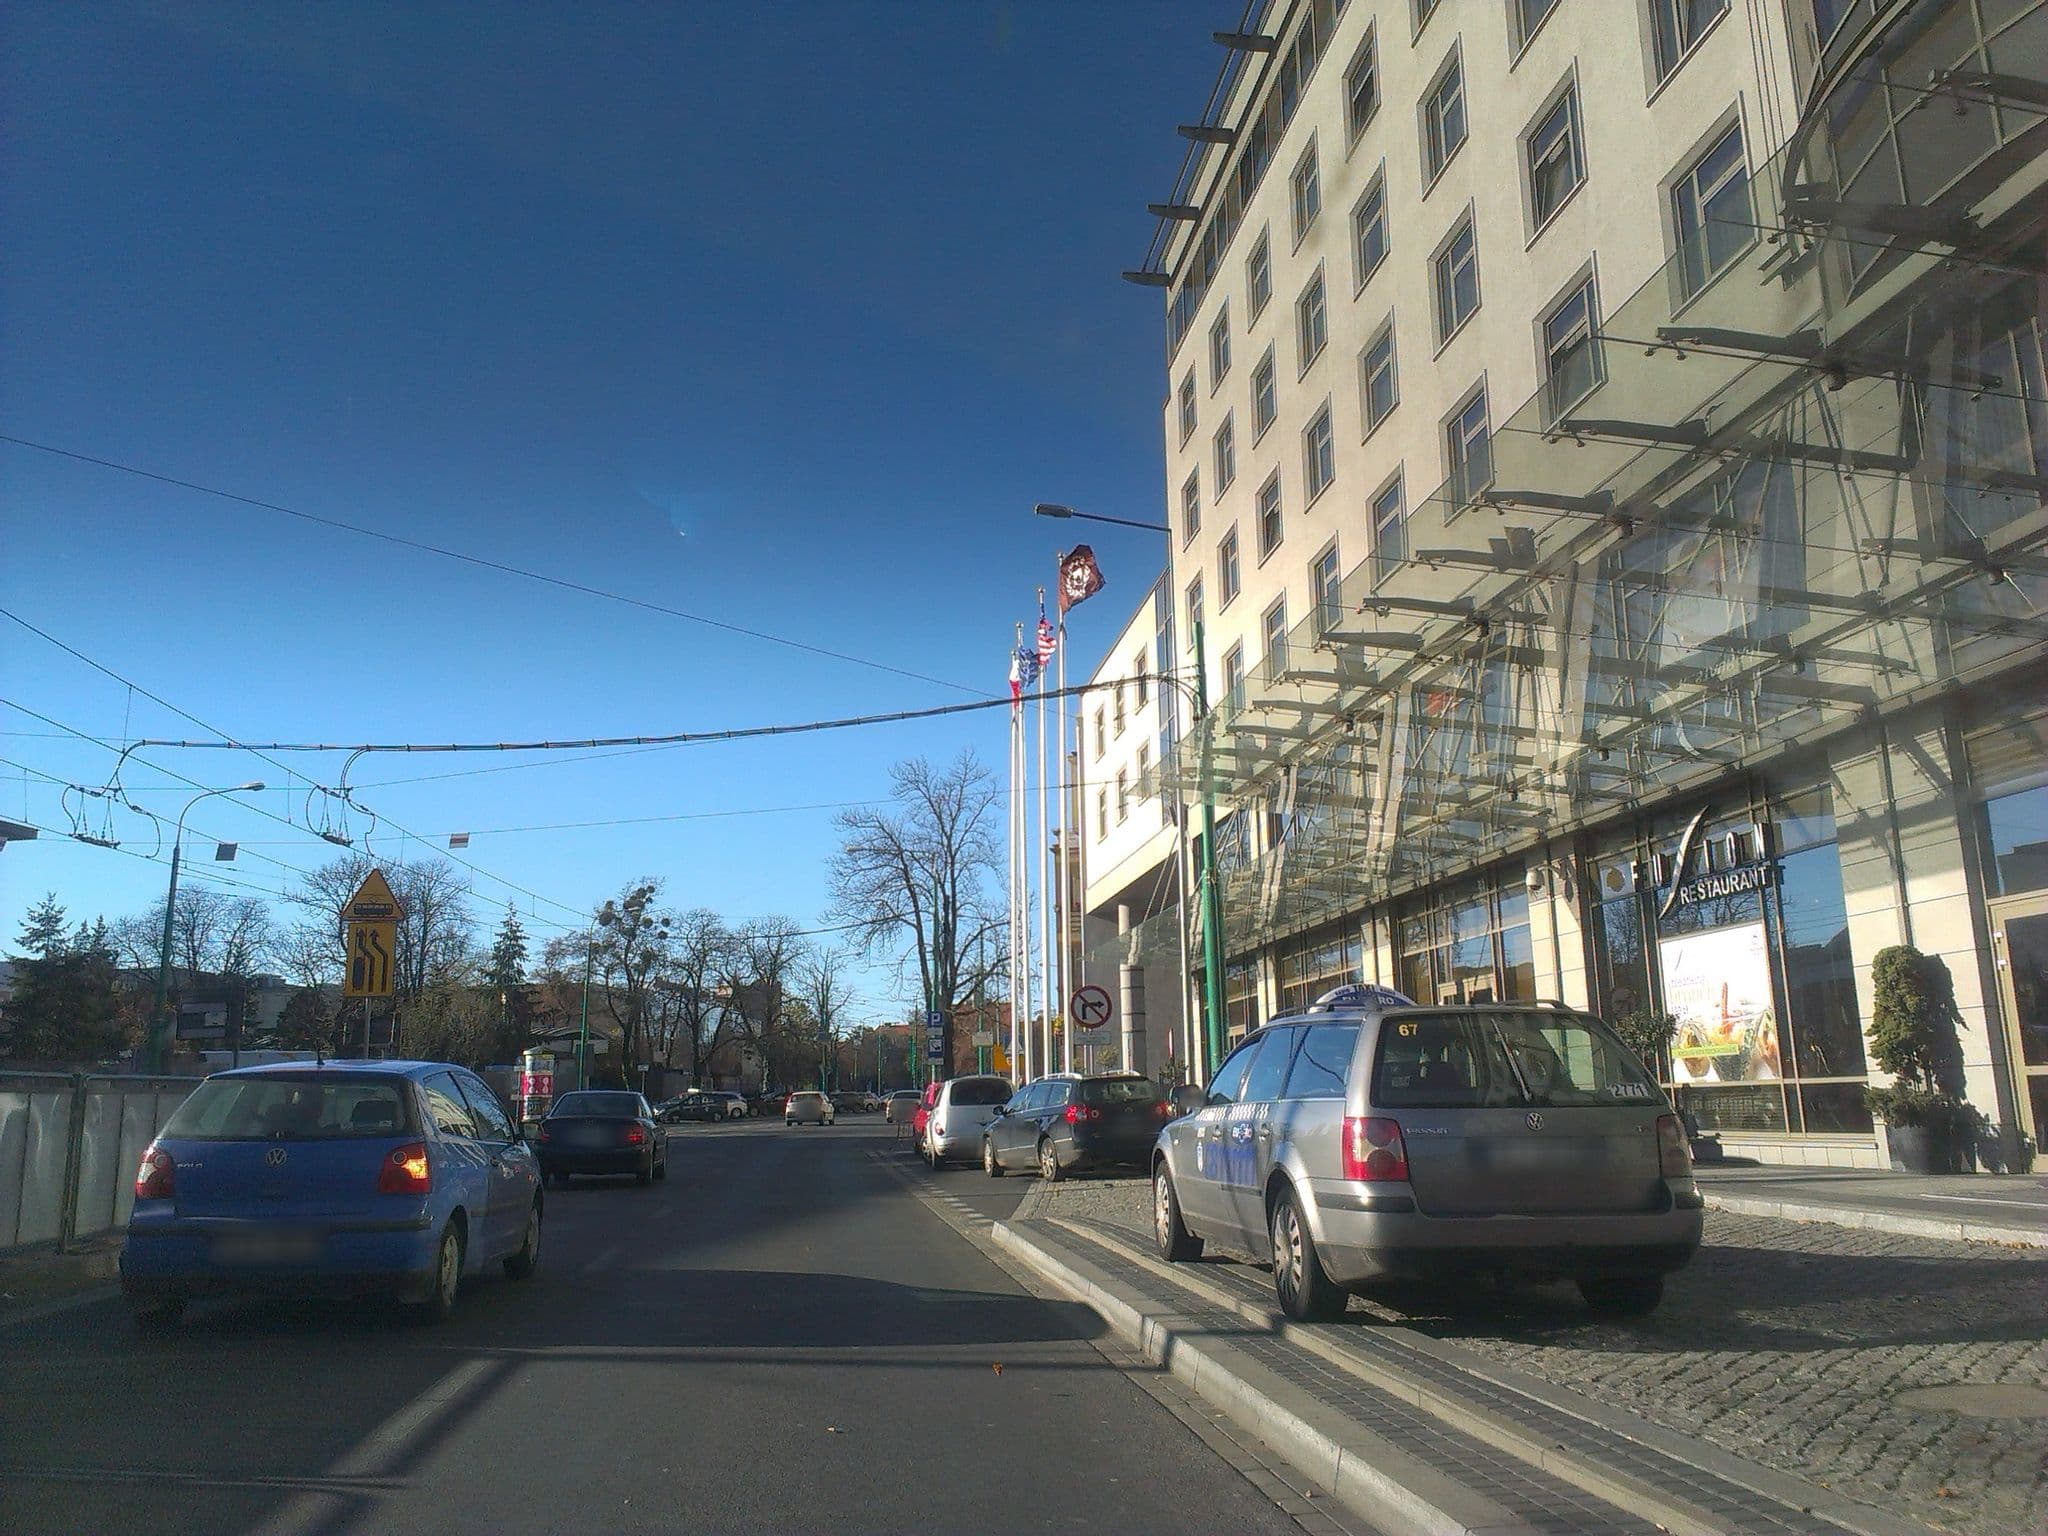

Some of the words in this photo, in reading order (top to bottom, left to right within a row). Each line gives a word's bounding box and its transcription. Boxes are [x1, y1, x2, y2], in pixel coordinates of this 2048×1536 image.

[1680, 866, 1768, 905] RESTAURANT
[1398, 1023, 1418, 1037] 67
[1611, 1083, 1645, 1097] 2771
